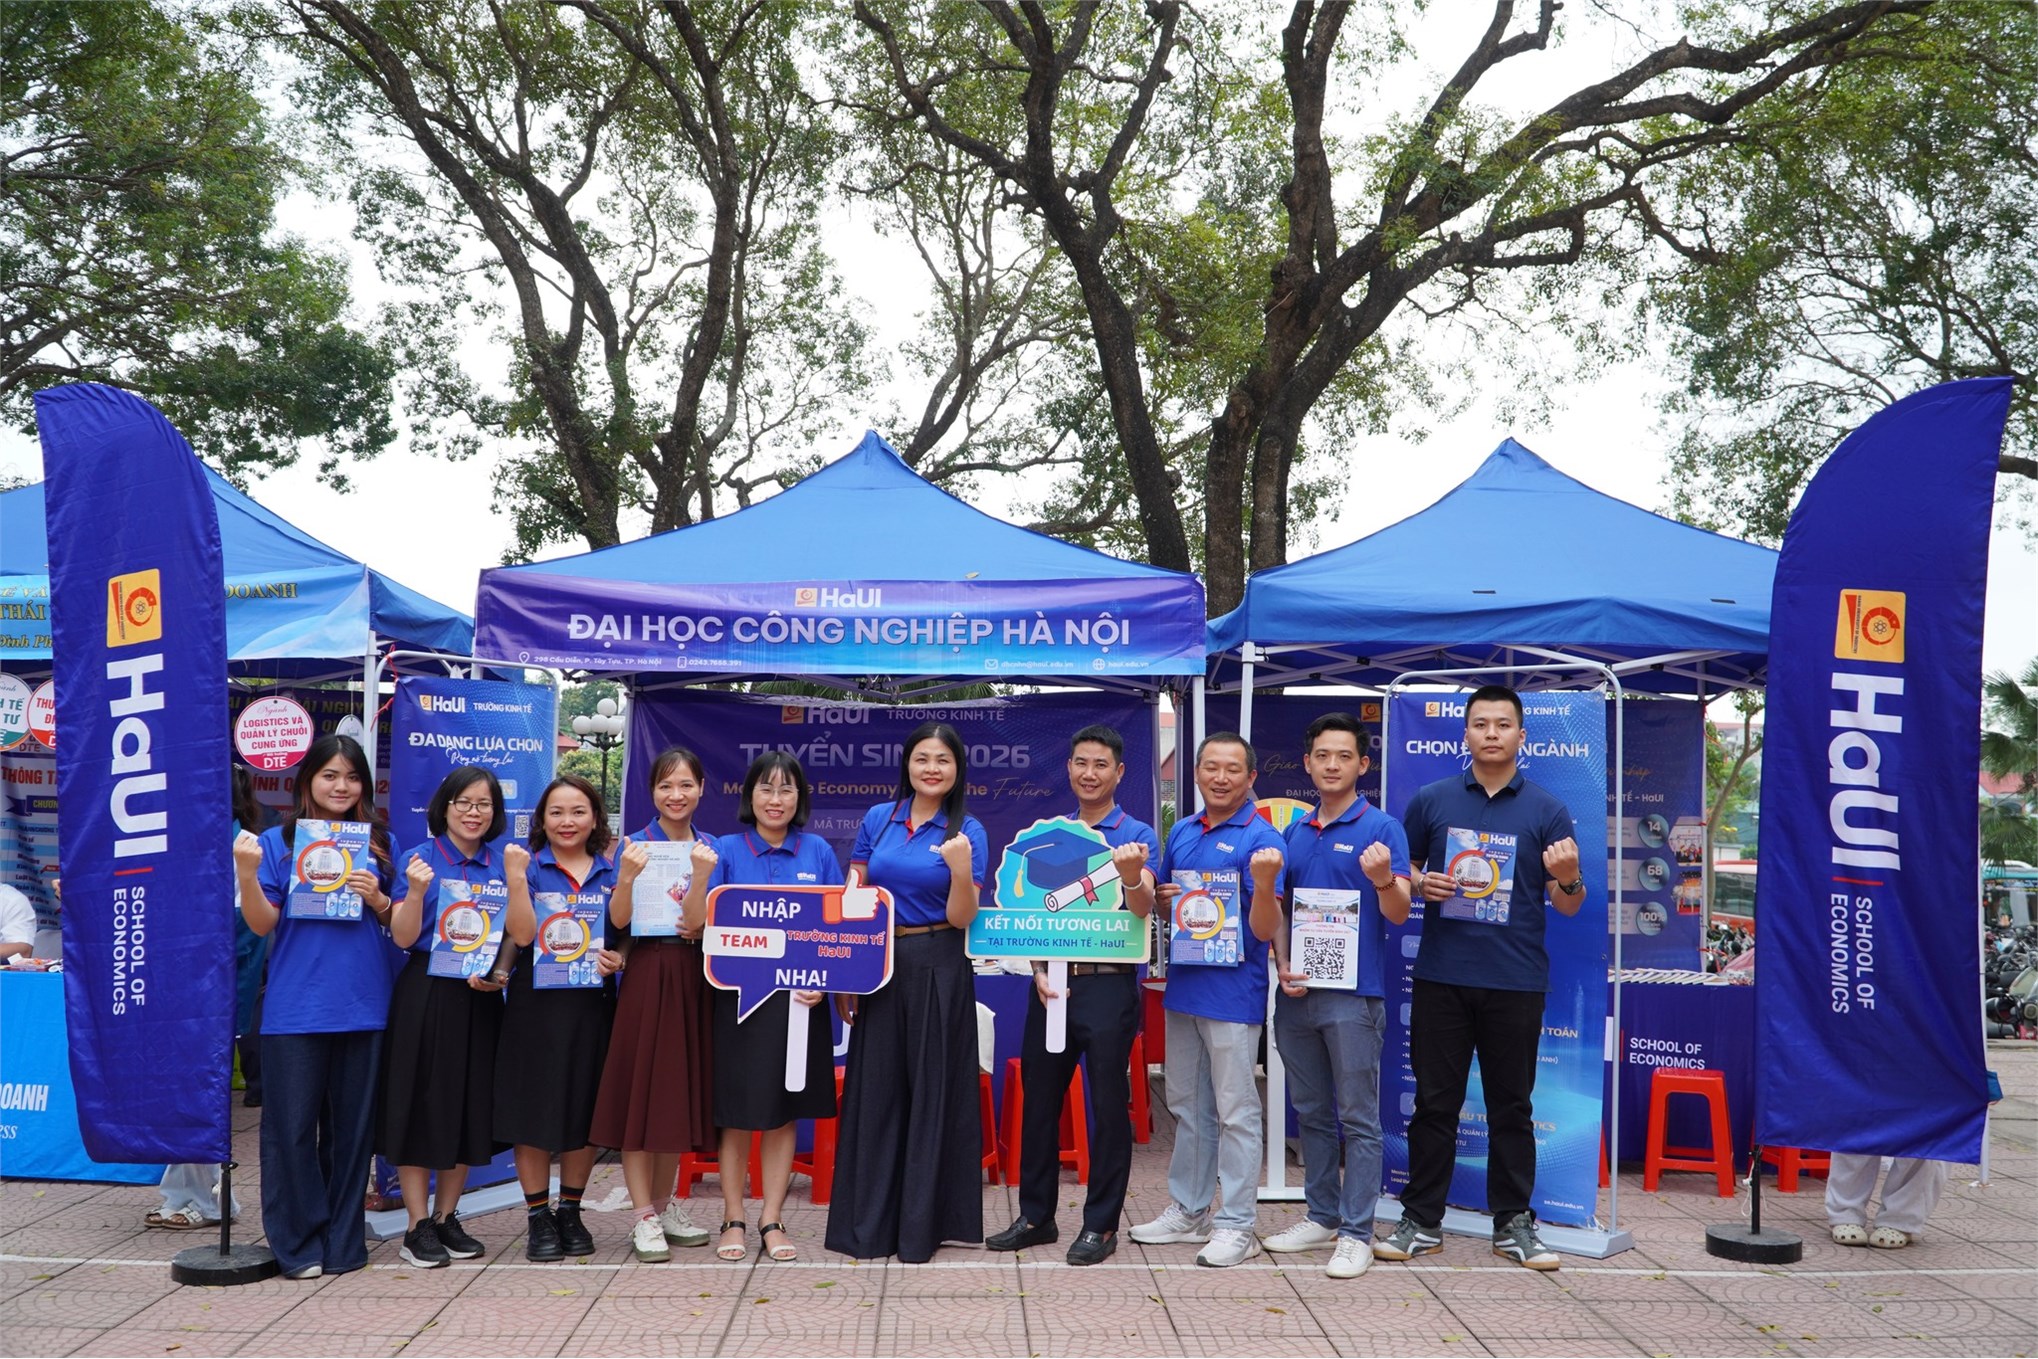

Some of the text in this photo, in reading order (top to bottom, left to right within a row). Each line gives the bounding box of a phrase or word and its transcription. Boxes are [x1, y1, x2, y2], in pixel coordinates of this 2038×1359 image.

[821, 587, 880, 609] HaUI
[567, 610, 1130, 654] ĐẠI HỌC CÔNG NGHIỆP HÀ NỘI
[433, 696, 466, 713] HaUI
[505, 704, 522, 714] KINH
[1441, 701, 1467, 718] Ha
[1533, 706, 1556, 716] KINH
[243, 717, 289, 729] LOGISTICS
[950, 709, 984, 721] KINH
[251, 740, 276, 750] CUNG
[408, 731, 543, 754] ĐA DẠNG LỰA CHỌN
[1406, 740, 1458, 757] CHỌN
[1519, 737, 1589, 758] NGÀNH
[106, 652, 168, 859] HaUI
[263, 757, 287, 769] DTE
[1828, 671, 1905, 872] HaUI
[817, 782, 898, 799] Economy
[964, 782, 988, 796] he
[992, 776, 1054, 801] Future
[1642, 793, 1664, 803] HaUI
[341, 823, 369, 834] HaUI
[1647, 821, 1661, 832] 14
[1490, 835, 1516, 847] HaUI
[1212, 872, 1237, 883] HaUI
[1647, 864, 1663, 876] 68
[482, 885, 508, 897] HaUI
[577, 894, 604, 904] HaUI
[741, 897, 801, 923] NHẬP
[1639, 911, 1665, 922] 100%
[984, 913, 1130, 932] KẾT NỐI TƯƠNG LAI
[720, 933, 768, 949] TEAM
[786, 929, 886, 945] TRƯỜNG KINH TẾ
[988, 937, 1004, 947] TẠI
[1006, 935, 1050, 947] TRƯỜNG
[1052, 938, 1078, 947] KINH
[1080, 936, 1092, 948] TẾ
[1100, 938, 1125, 948] HaUI
[112, 888, 127, 1016] ECONOMICS
[130, 886, 146, 1006] SCHOOL OF
[818, 945, 851, 958] HaUI
[1830, 893, 1850, 1014] ECONOMICS
[1855, 896, 1875, 1010] SCHOOL OF
[775, 968, 828, 987] NHA!
[1546, 1026, 1578, 1039] TOÁN
[1630, 1037, 1703, 1055] SCHOOL OF
[1629, 1052, 1706, 1070] ECONOMICS
